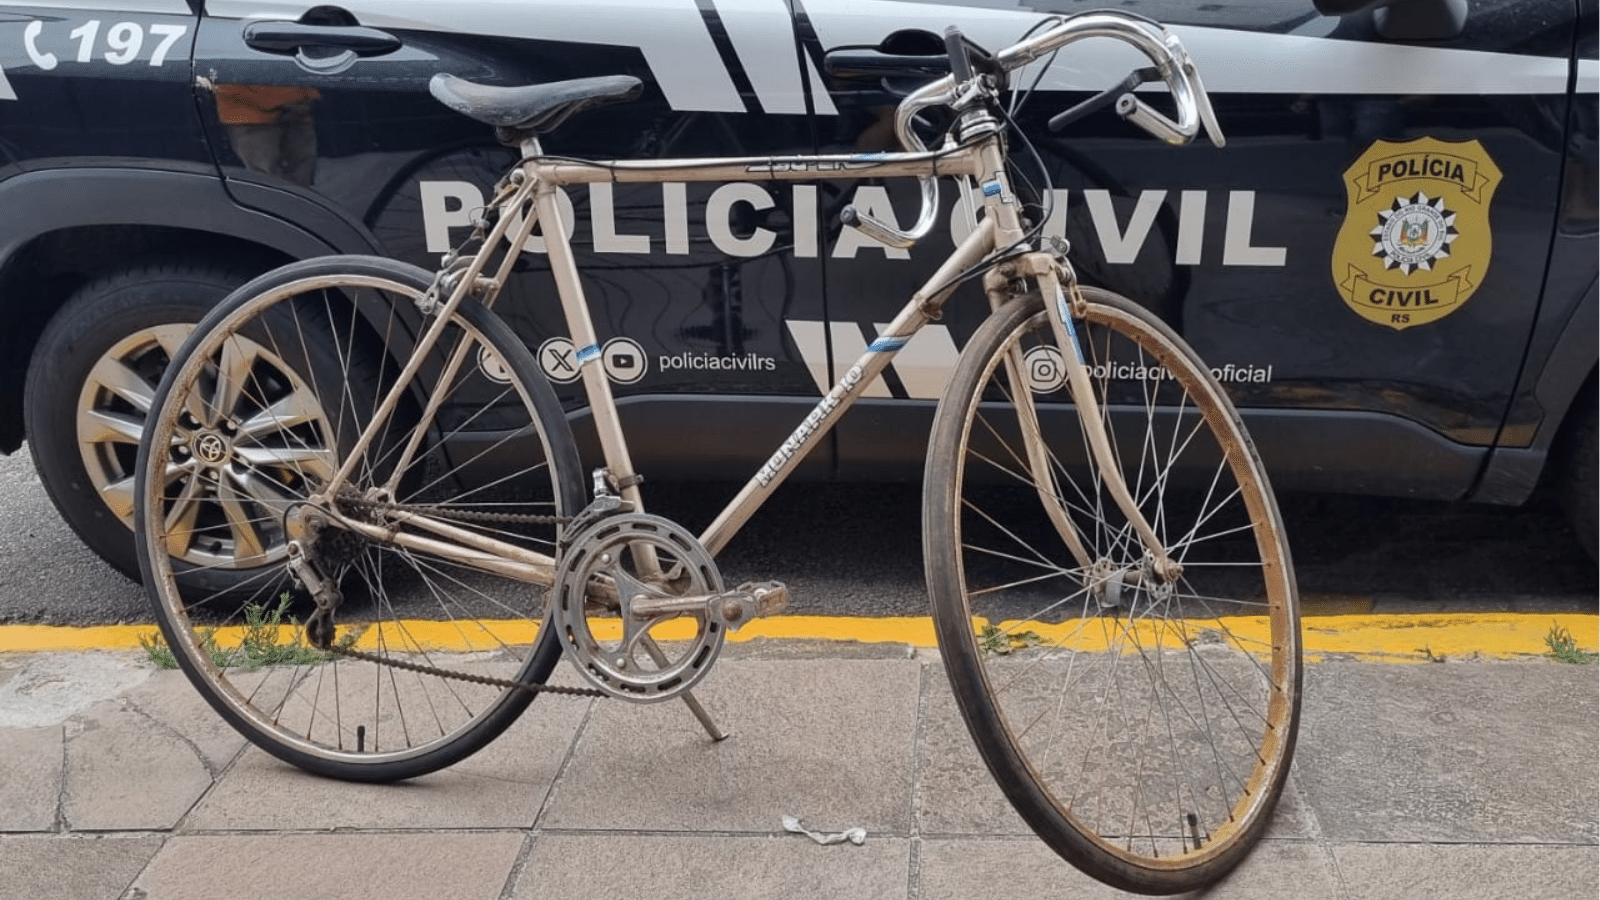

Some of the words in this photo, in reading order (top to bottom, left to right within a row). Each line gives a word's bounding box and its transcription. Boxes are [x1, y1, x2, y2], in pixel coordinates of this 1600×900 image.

[70, 20, 187, 66] 197
[1378, 155, 1464, 182] POLÍCIA
[1369, 289, 1439, 307] CIVIL
[1391, 313, 1411, 323] RS
[659, 352, 776, 373] policiacivilrs
[753, 391, 842, 488] MONARK
[839, 364, 864, 393] 10
